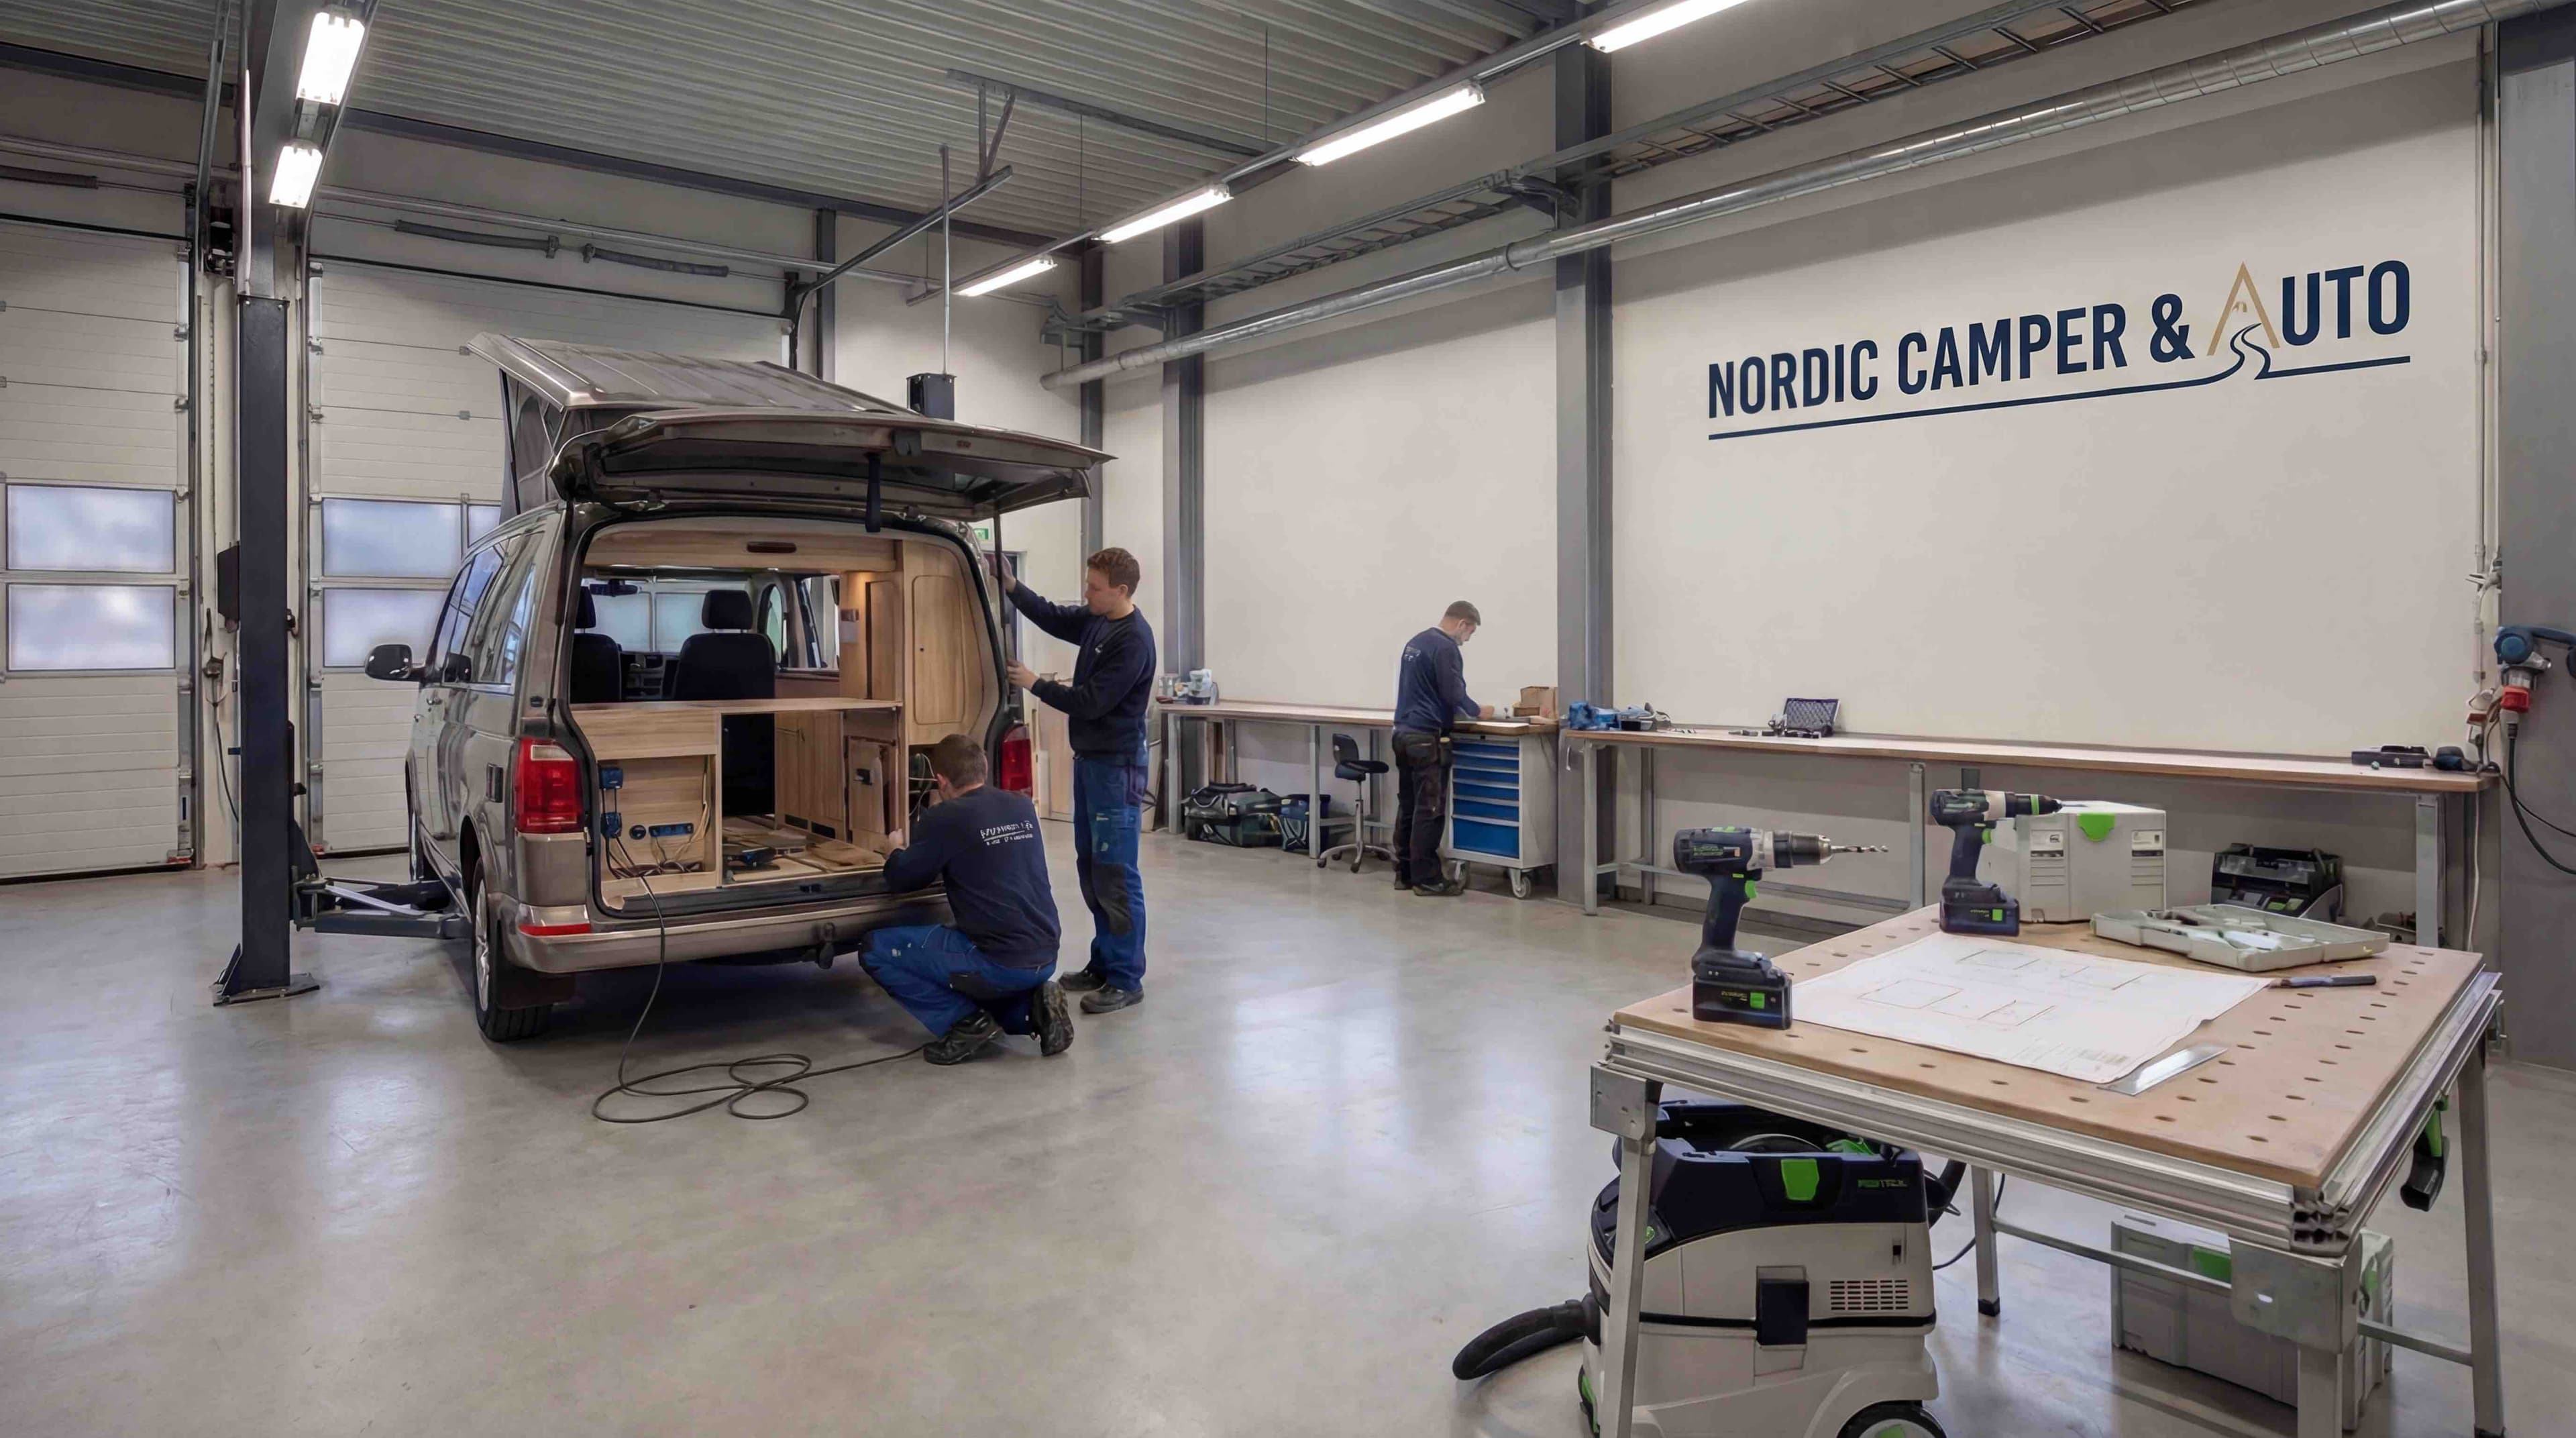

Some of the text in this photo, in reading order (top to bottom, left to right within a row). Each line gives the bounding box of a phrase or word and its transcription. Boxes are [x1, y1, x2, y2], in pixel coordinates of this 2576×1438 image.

[1709, 260, 2410, 419] NORDIC CAMPER & AUTO
